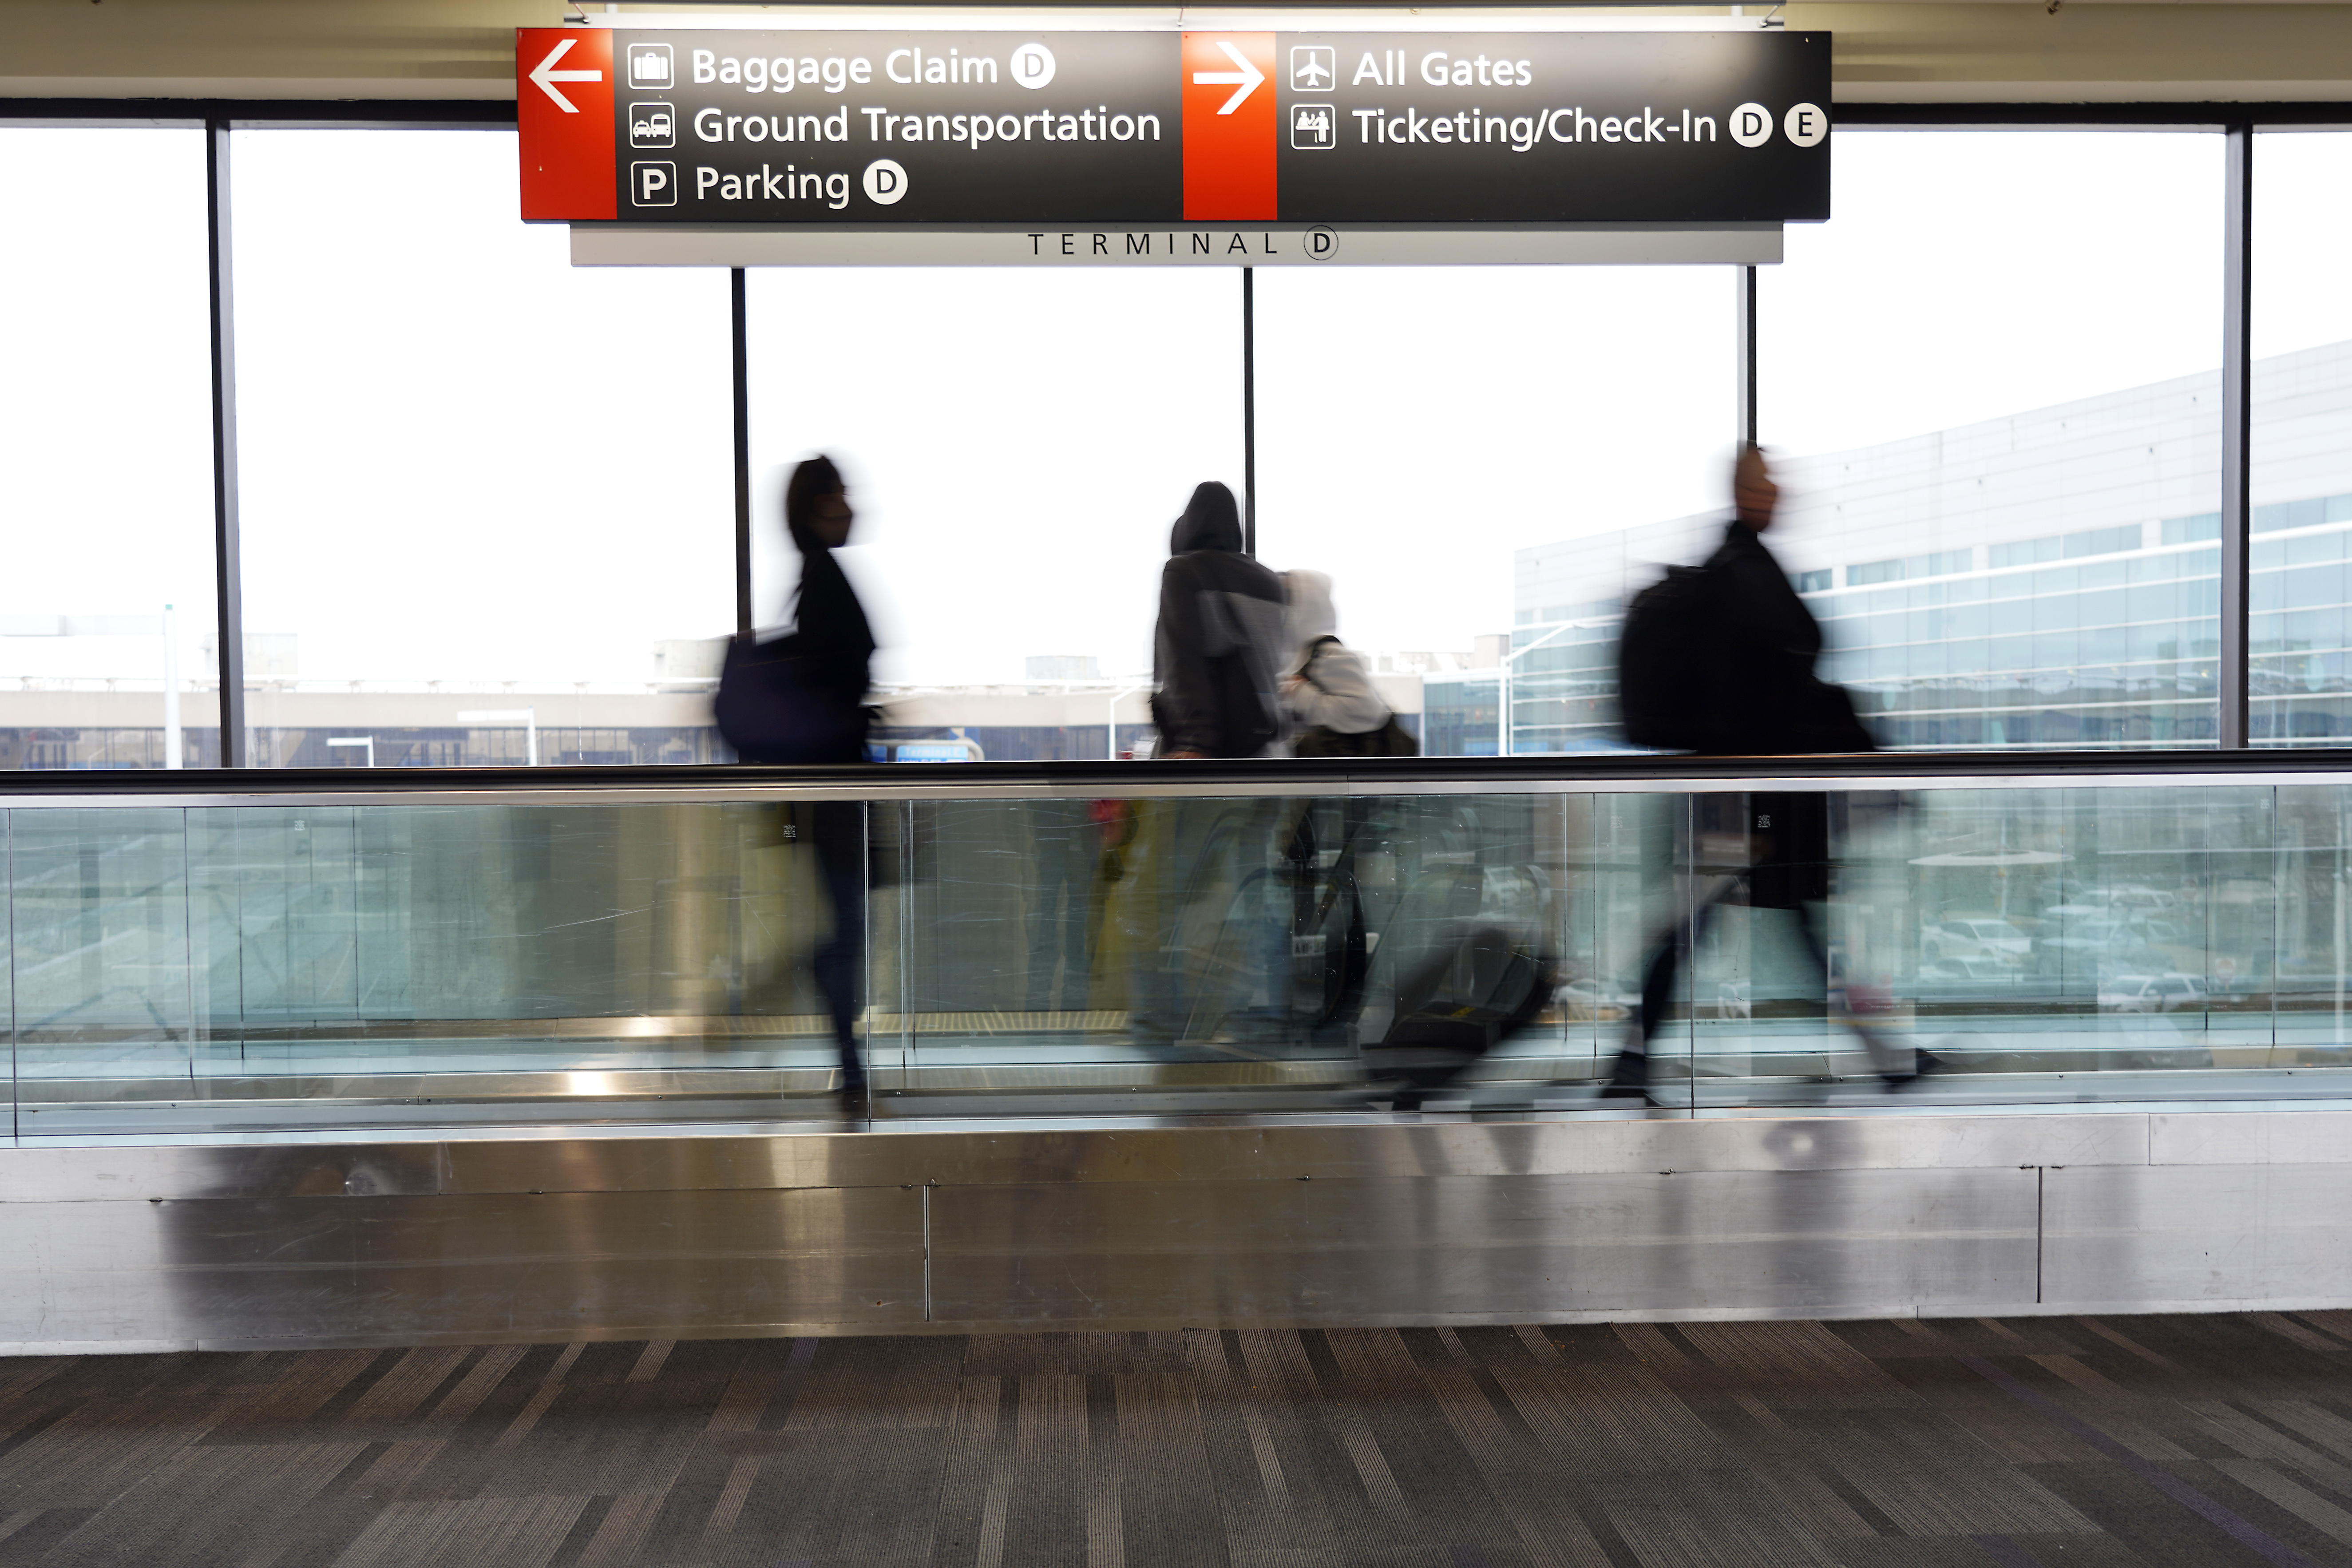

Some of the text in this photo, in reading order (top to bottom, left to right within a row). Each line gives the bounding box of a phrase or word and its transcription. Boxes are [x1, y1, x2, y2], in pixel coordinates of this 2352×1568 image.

[693, 46, 1045, 93] Baggage Claim D
[1352, 49, 1532, 86] All Gates
[693, 105, 1160, 150] Ground Transportation
[1351, 106, 1812, 152] Ticketing/Check-In D E
[643, 169, 667, 199] P
[697, 163, 897, 210] Parking D
[1028, 233, 1330, 256] TERMINAL D
